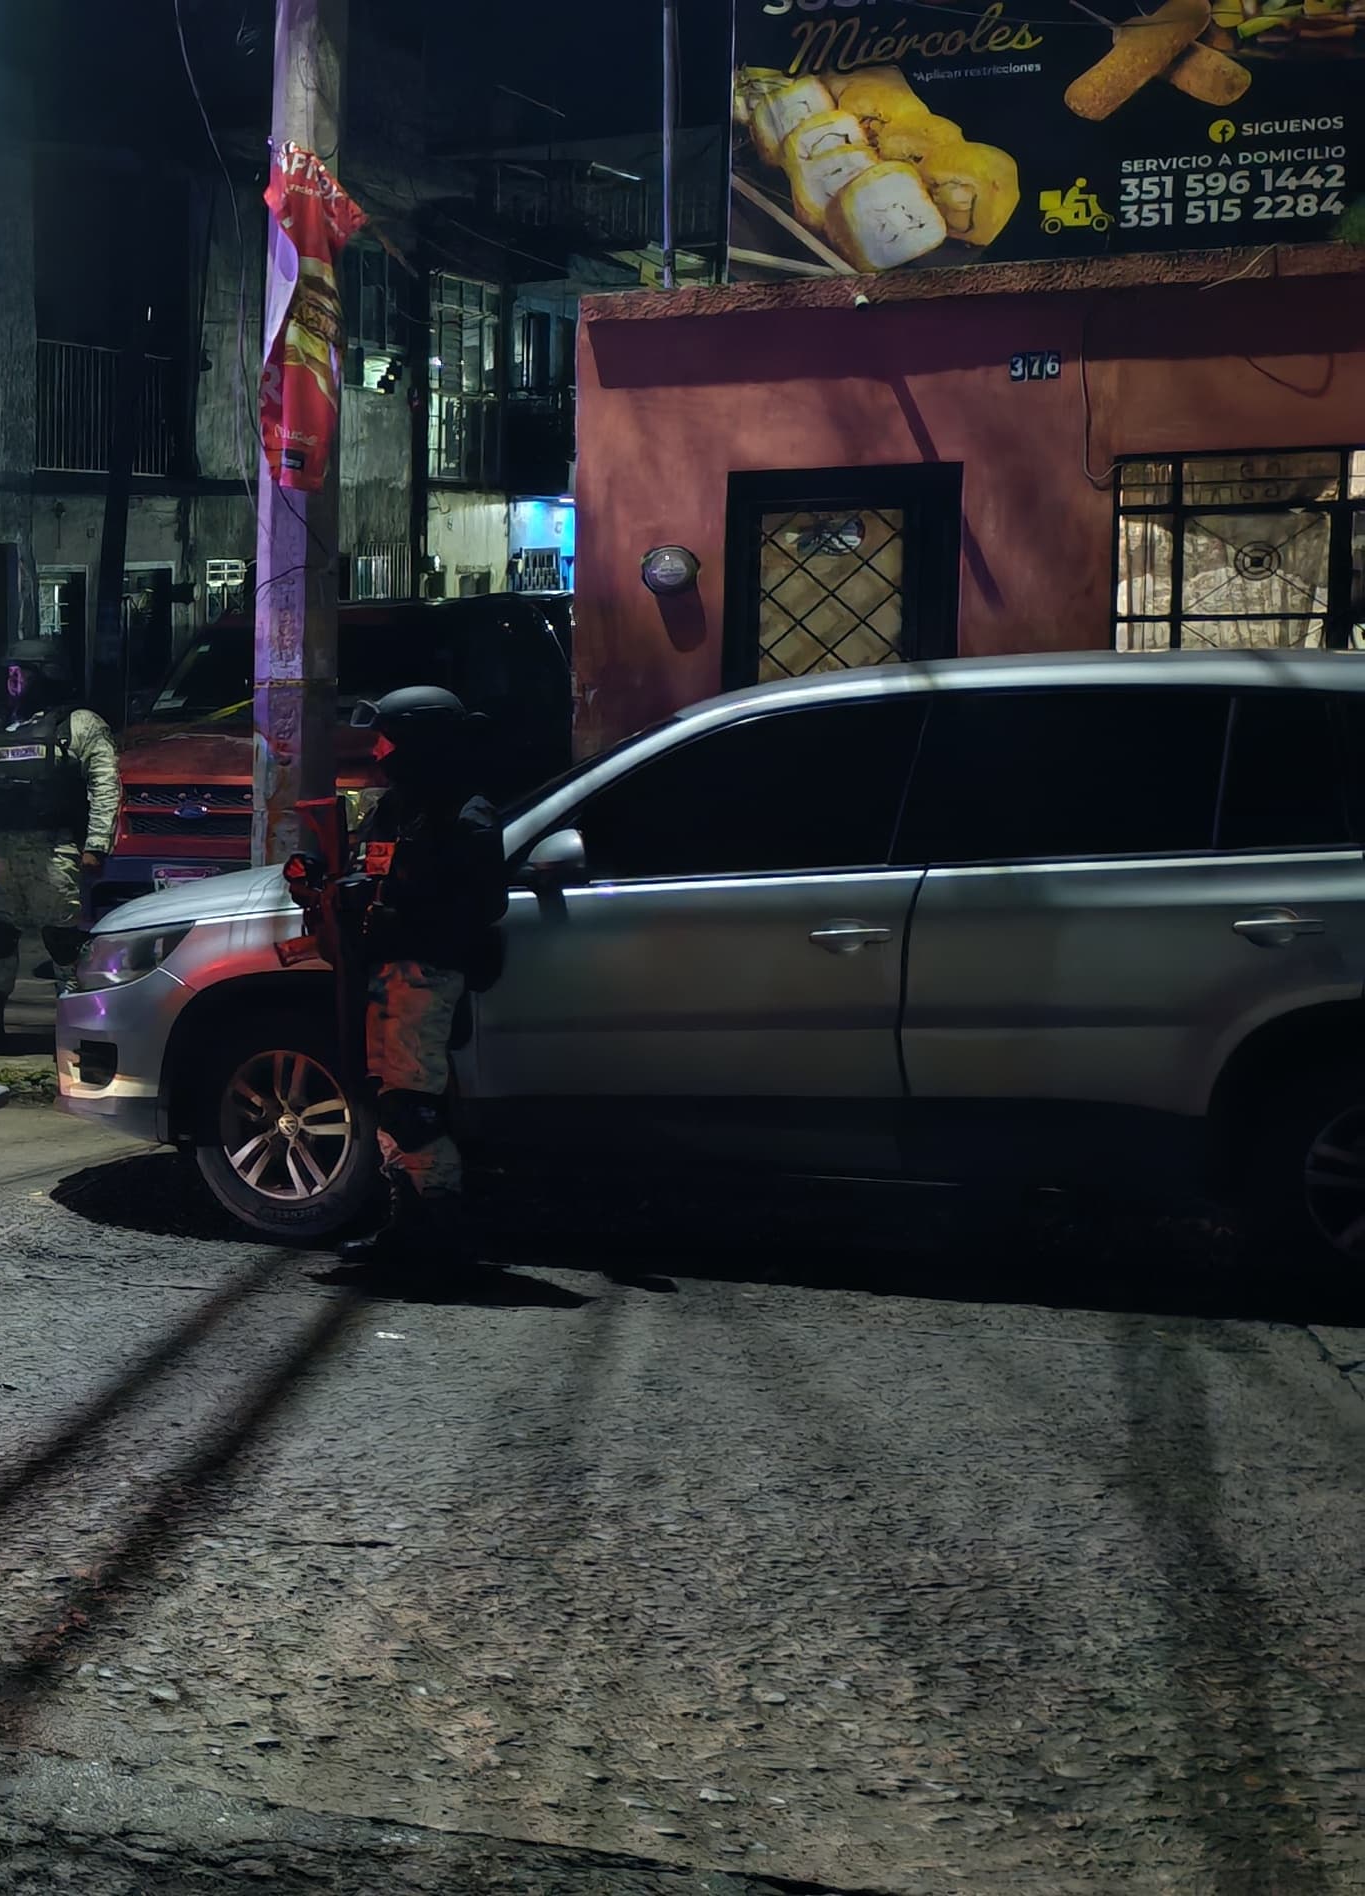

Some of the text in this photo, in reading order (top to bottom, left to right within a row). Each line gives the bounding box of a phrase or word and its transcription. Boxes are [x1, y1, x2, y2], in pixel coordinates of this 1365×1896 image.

[789, 2, 1043, 75] Miércoles
[1241, 116, 1344, 136] SIGUENOS
[1121, 145, 1346, 173] SERVICIO A DOMICILIO
[1120, 164, 1346, 201] 351 596 1442
[1120, 192, 1345, 228] 351 515 2284
[1011, 355, 1060, 377] 376
